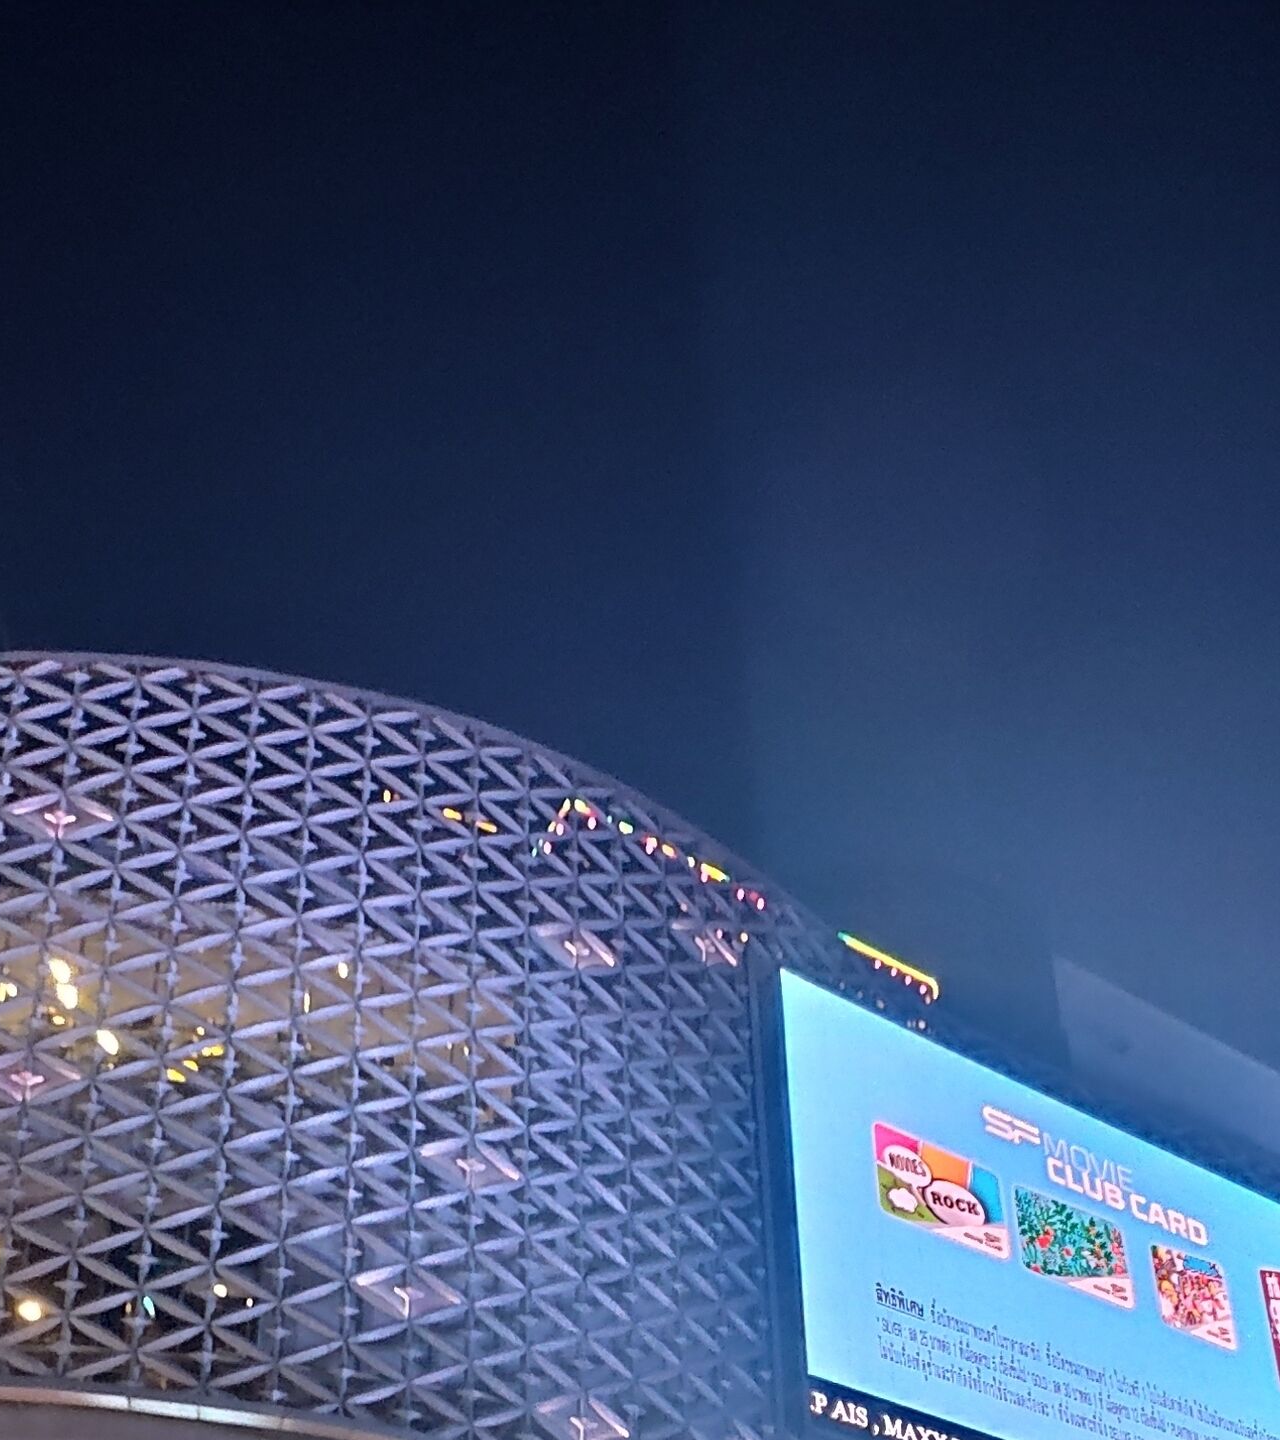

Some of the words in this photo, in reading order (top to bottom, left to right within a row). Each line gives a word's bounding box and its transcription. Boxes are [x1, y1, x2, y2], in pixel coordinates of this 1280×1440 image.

[982, 1105, 1040, 1144] SF
[1042, 1132, 1133, 1192] MOVIE
[931, 1191, 980, 1216] ROCK
[1047, 1157, 1126, 1210] CLUB
[1129, 1193, 1208, 1246] CARD
[830, 1399, 868, 1428] AIS
